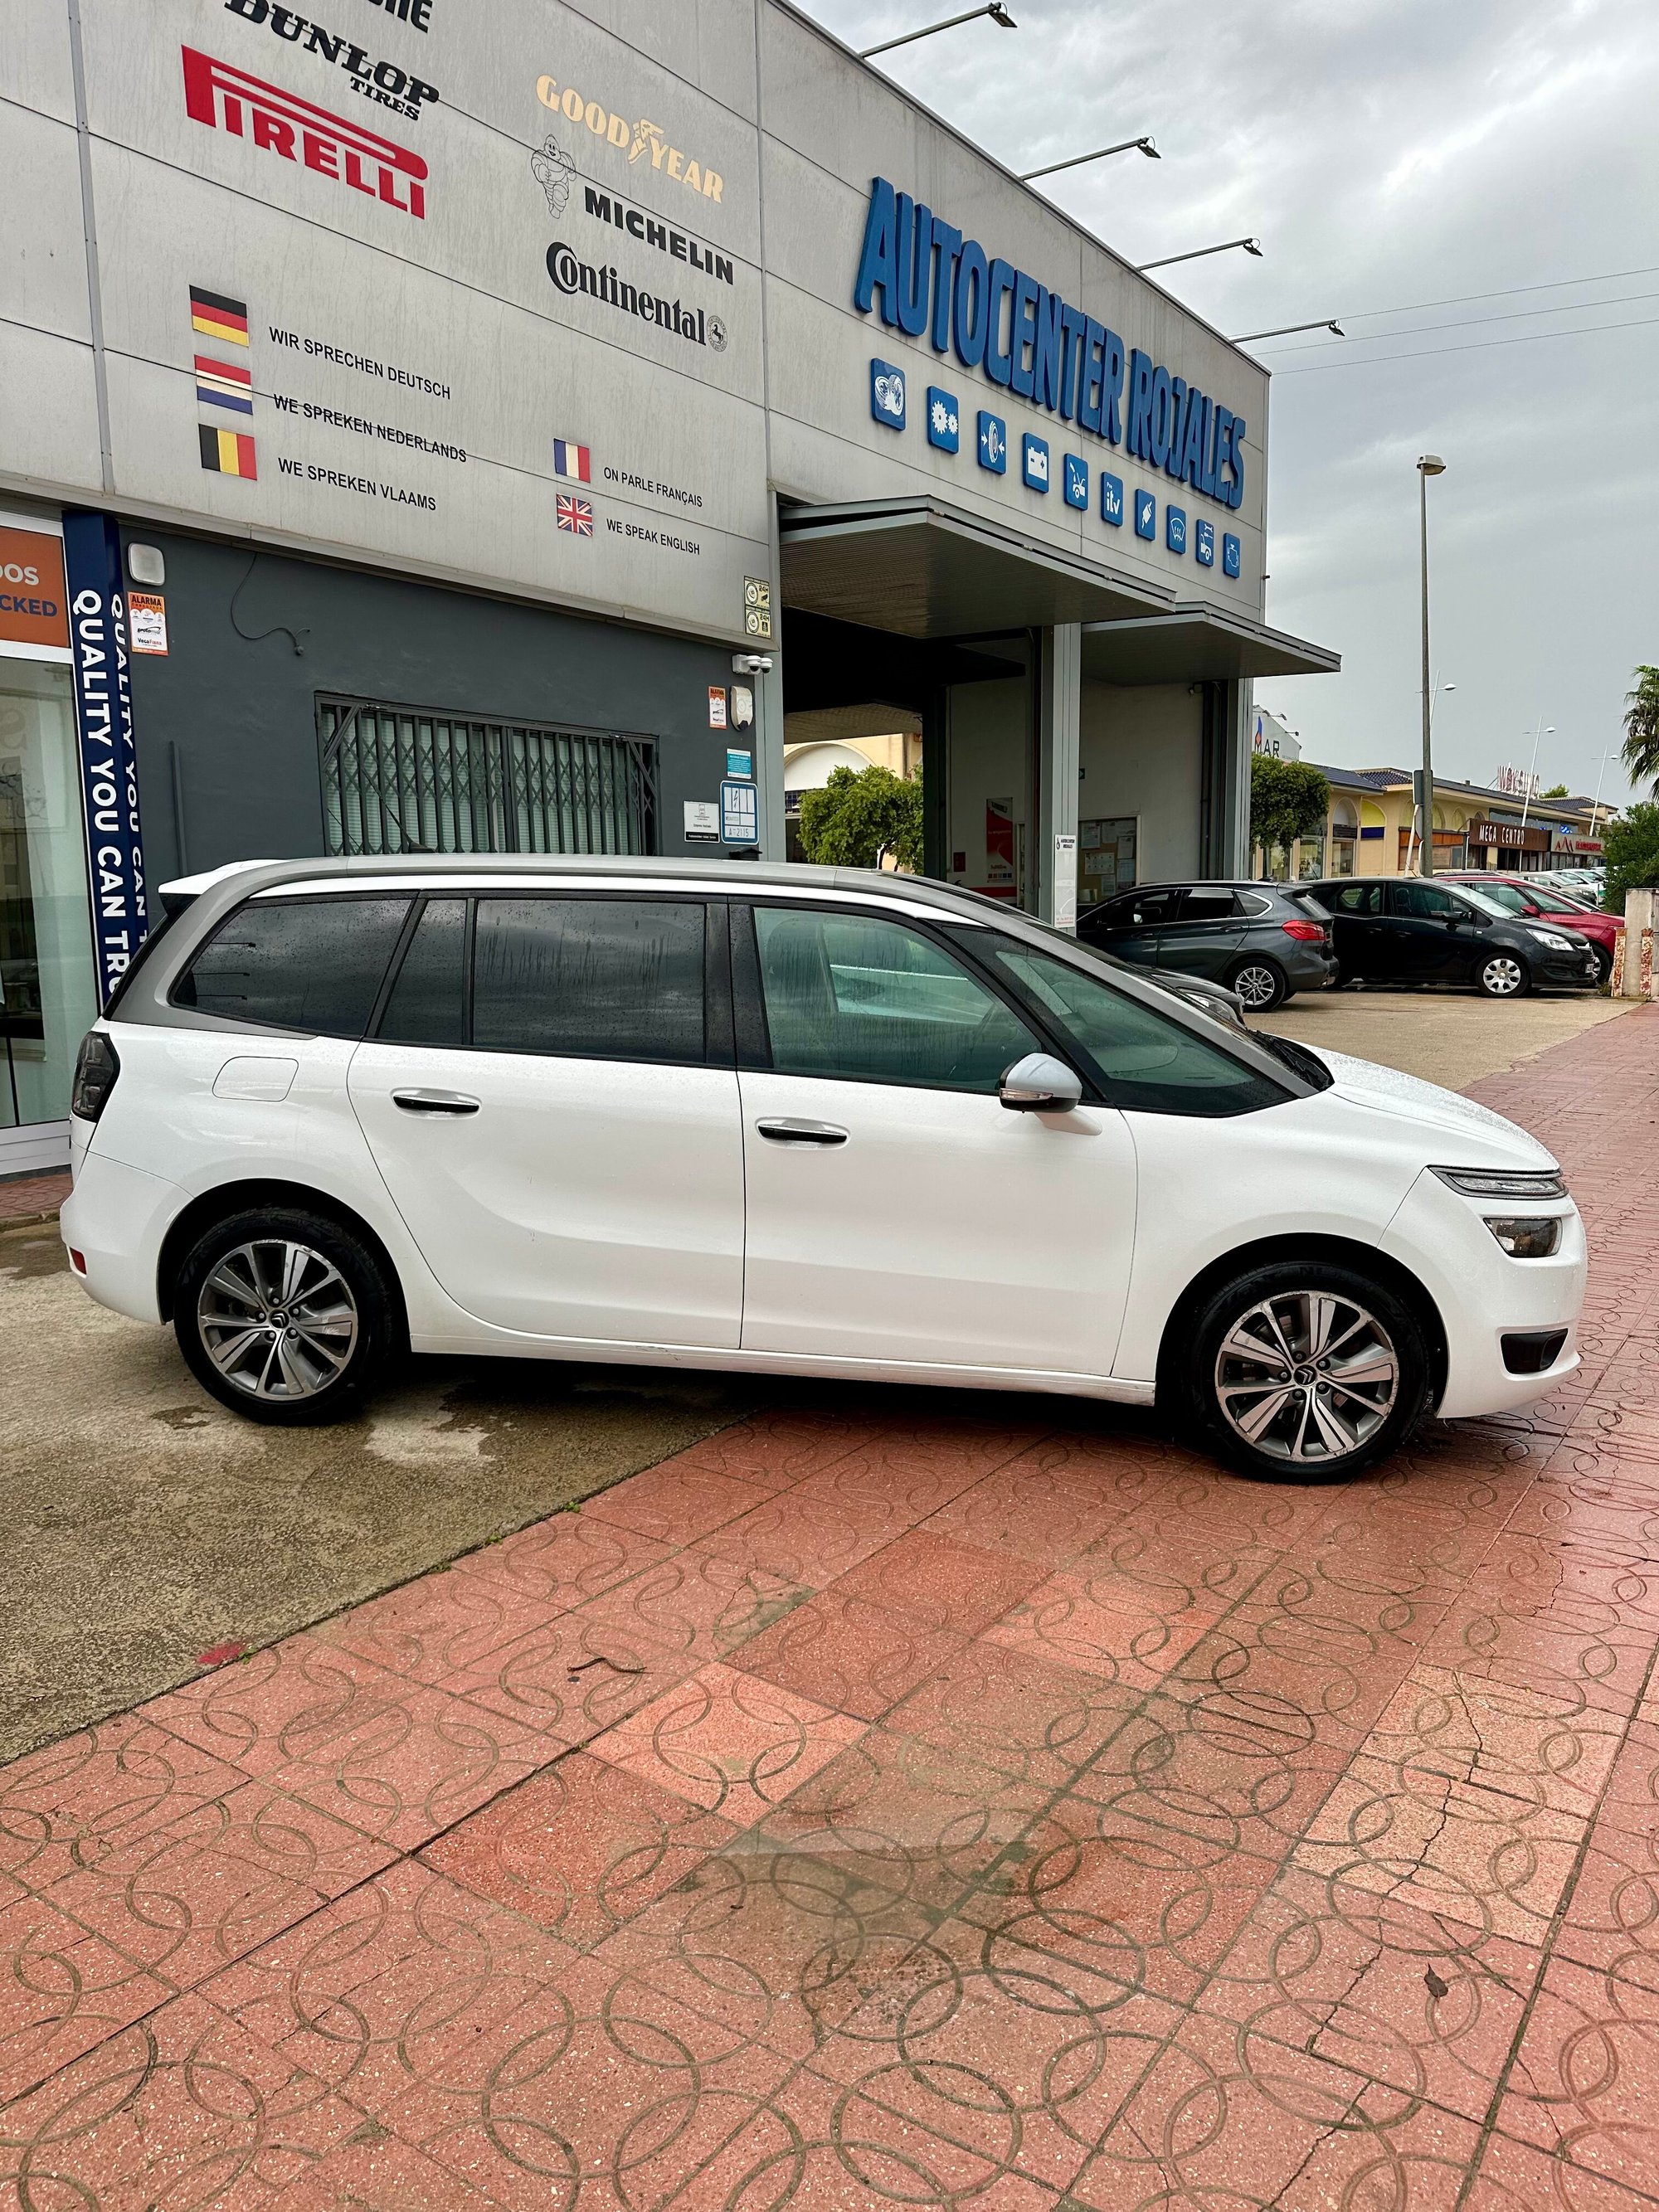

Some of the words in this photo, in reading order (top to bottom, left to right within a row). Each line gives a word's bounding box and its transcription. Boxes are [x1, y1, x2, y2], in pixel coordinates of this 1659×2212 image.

[224, 0, 440, 106] DUNLOP
[181, 44, 429, 220] PIRELLI
[350, 75, 421, 122] TIRES
[584, 185, 735, 286] MICHELIN
[545, 241, 708, 347] Continental
[269, 326, 300, 351] WIR
[304, 338, 384, 378] SPRECHEN
[387, 366, 451, 400] DEUTSCH
[854, 176, 1126, 445] AUTOCENTER
[1126, 348, 1247, 510] ROJALES
[274, 393, 299, 415] WE
[303, 402, 373, 436] SPREKEN
[377, 424, 467, 463] NEDERLANDS
[278, 457, 304, 478] WE
[307, 465, 377, 496] SPREKEN
[380, 484, 437, 512] VLAAMS
[603, 466, 619, 483] ON
[621, 471, 654, 493] PARLE
[656, 483, 703, 508] FRANÇAIS
[1107, 490, 1121, 515] itv
[606, 518, 623, 535] WE
[625, 523, 659, 545] SPEAK
[660, 533, 701, 556] ENGLISH
[0, 563, 40, 586] OS
[131, 595, 162, 607] ALARMA
[72, 590, 113, 747] QUALITY
[110, 593, 134, 750] QUALITY
[125, 761, 139, 833] YOU
[132, 846, 146, 916] CAN
[90, 757, 120, 832] YOU
[1478, 824, 1497, 843] MEGA
[1501, 826, 1525, 845] CENTRO
[97, 845, 127, 917] CAN
